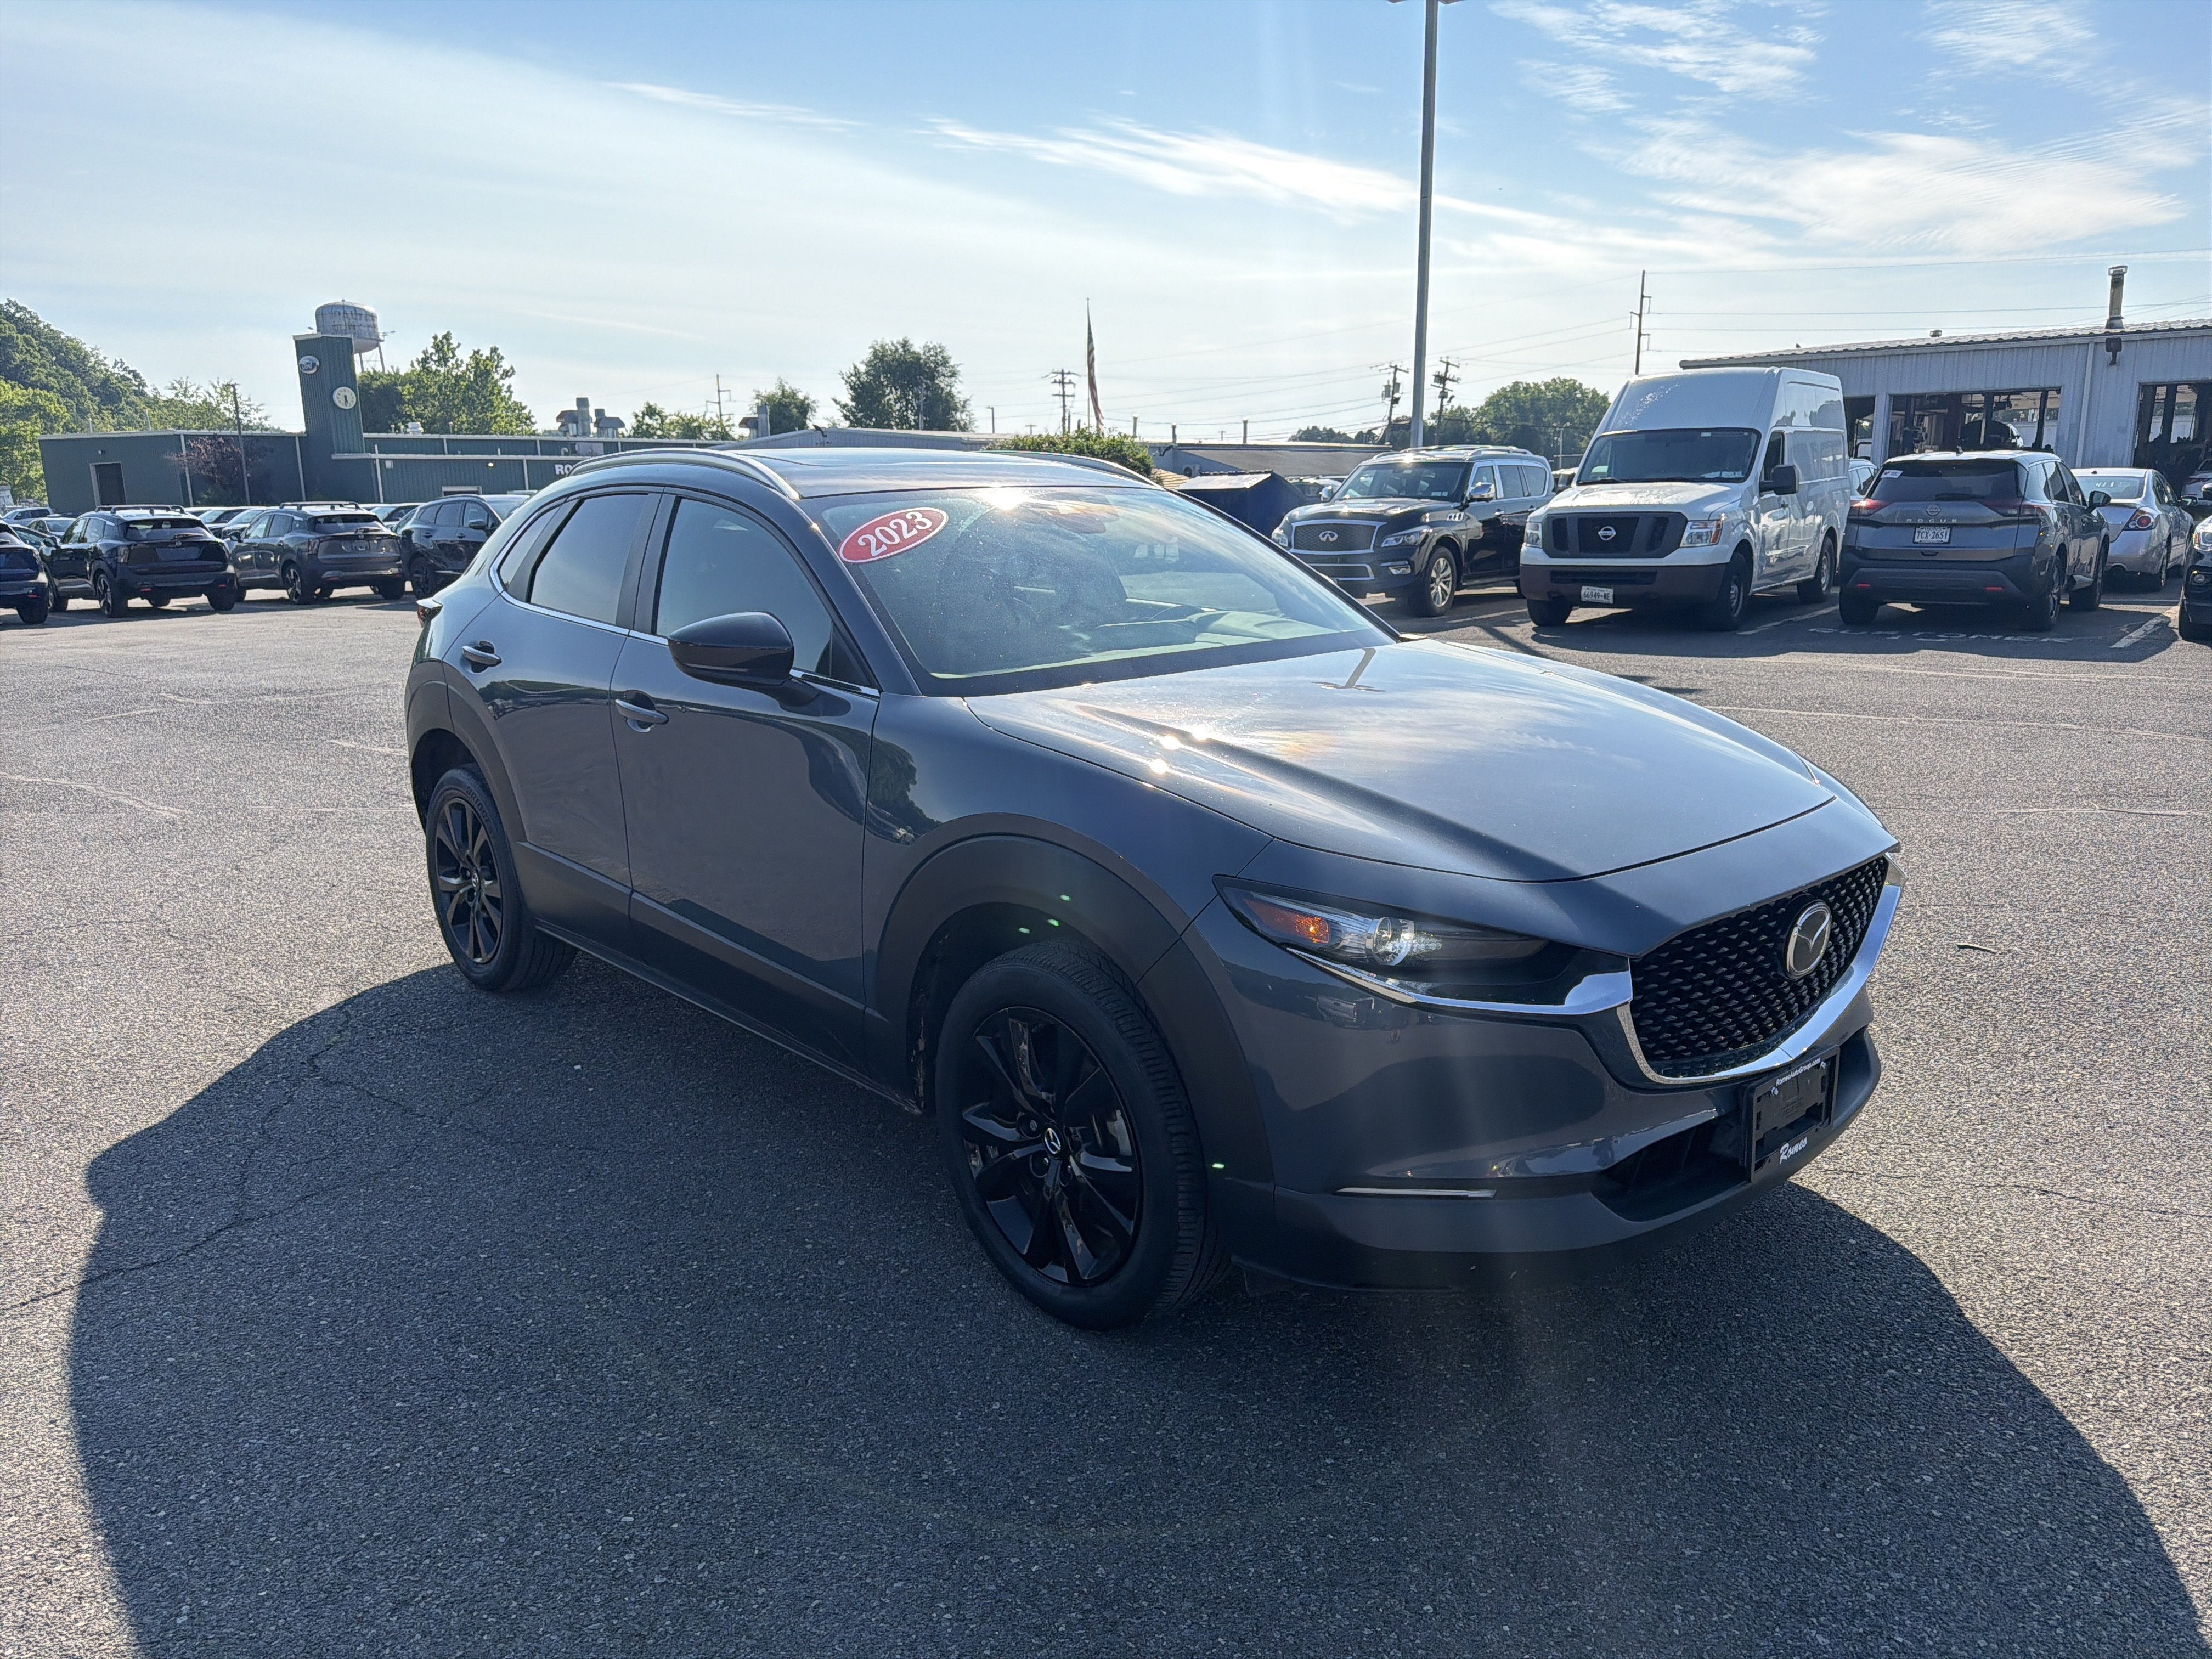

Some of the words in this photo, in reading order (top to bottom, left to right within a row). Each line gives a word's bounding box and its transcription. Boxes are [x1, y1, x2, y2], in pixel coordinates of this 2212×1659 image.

[555, 464, 575, 475] RO
[857, 511, 932, 557] 2023
[1776, 1057, 1821, 1086] RomeoAutoGroup.com
[1779, 1137, 1808, 1165] Romeo
